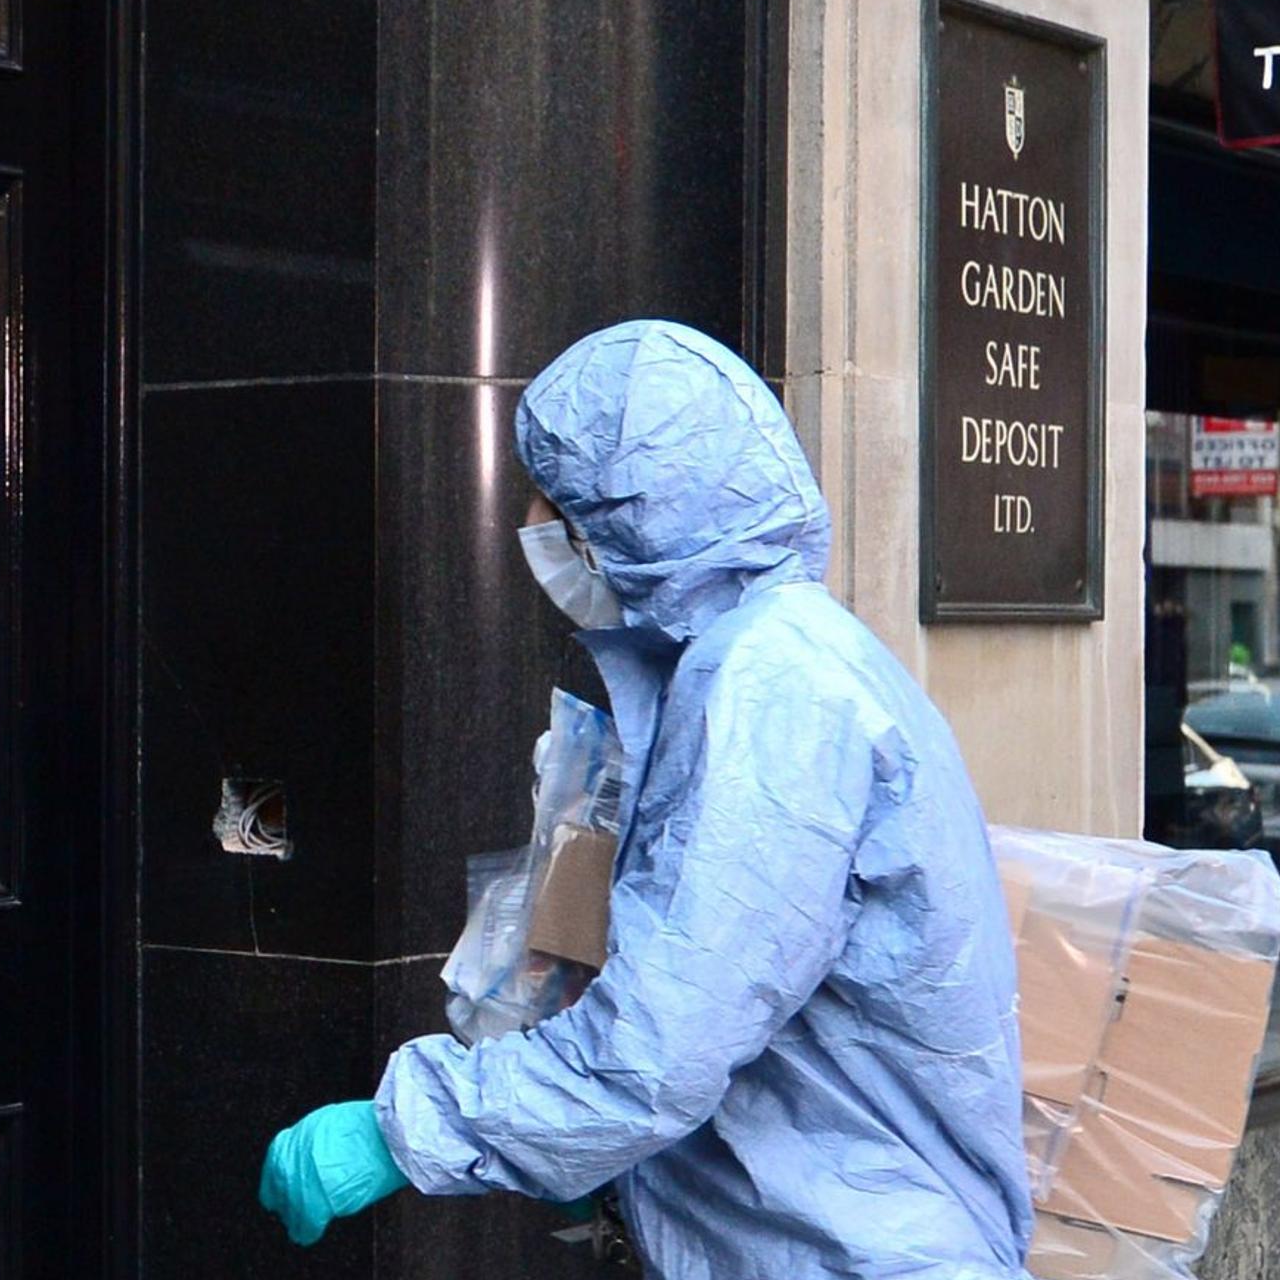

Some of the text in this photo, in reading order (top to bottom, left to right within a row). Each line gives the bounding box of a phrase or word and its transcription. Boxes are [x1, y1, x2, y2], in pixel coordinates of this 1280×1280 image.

[960, 181, 1065, 245] HATTON
[960, 260, 1066, 319] GARDEN
[985, 340, 1041, 391] SAFE
[960, 415, 1065, 470] DEPOSIT
[993, 493, 1036, 534] LTD.
